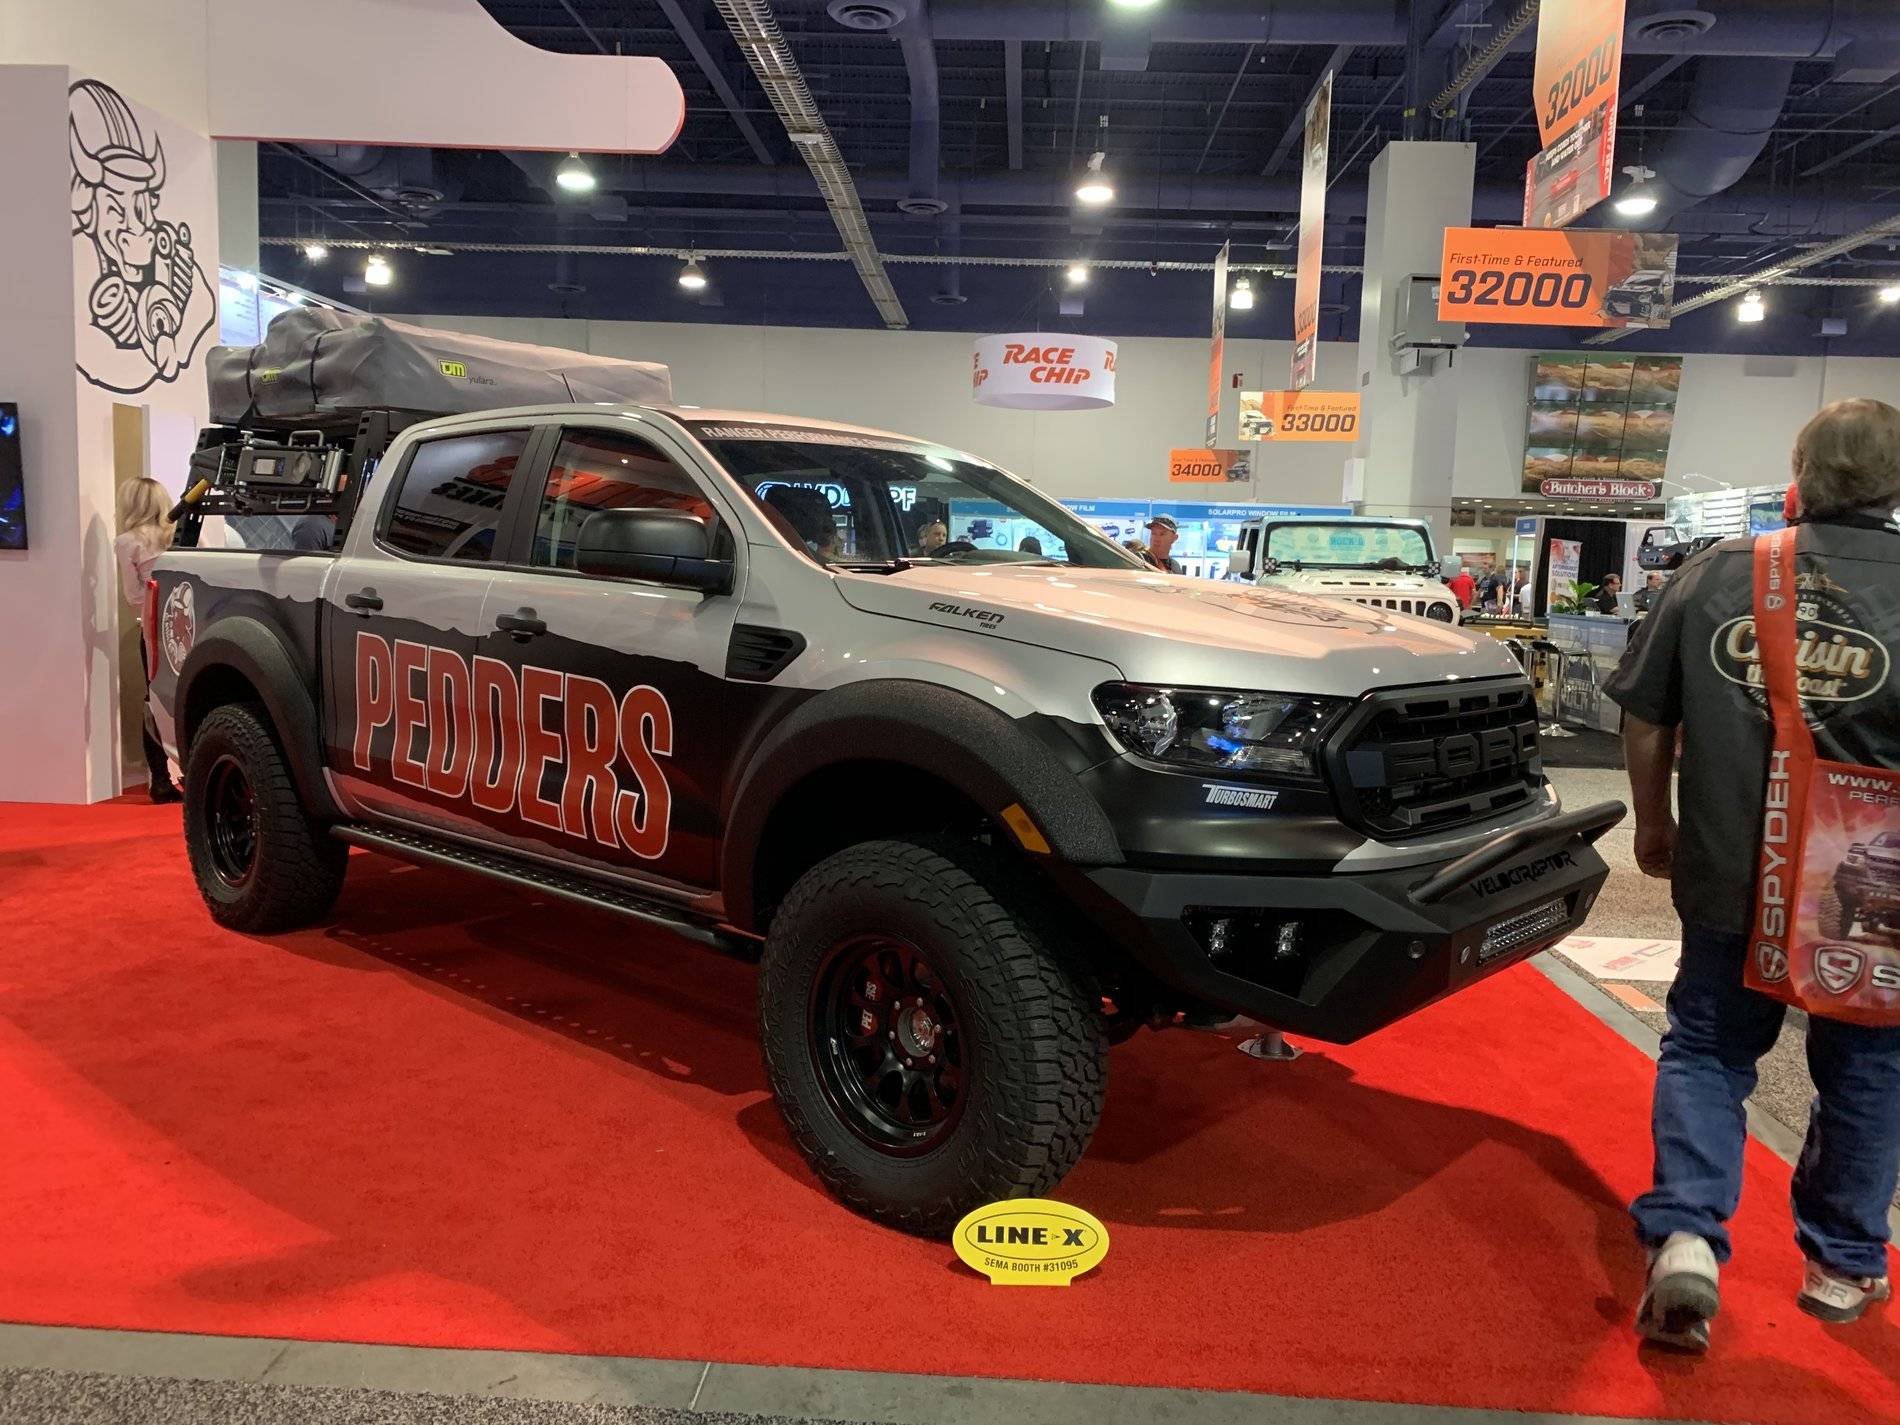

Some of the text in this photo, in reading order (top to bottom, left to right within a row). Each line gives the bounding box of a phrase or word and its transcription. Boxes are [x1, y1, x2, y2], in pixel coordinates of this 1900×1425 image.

[1545, 32, 1617, 130] 32000
[1450, 253, 1584, 268] First-Time & Featured
[1447, 269, 1593, 309] 32000
[1003, 344, 1076, 364] RACE
[1029, 366, 1091, 385] CHIP
[700, 426, 764, 439] RANGER
[1280, 413, 1356, 433] 33000
[1171, 463, 1222, 476] 34000
[1550, 480, 1647, 497] Butcher's Block
[1208, 508, 1247, 517] SOLARPRO
[928, 602, 1005, 623] FALKEN
[352, 630, 673, 860] PEDDERS
[1201, 783, 1280, 810] TURBOSMART
[984, 1257, 1079, 1273] SEMA BOOTH #31095
